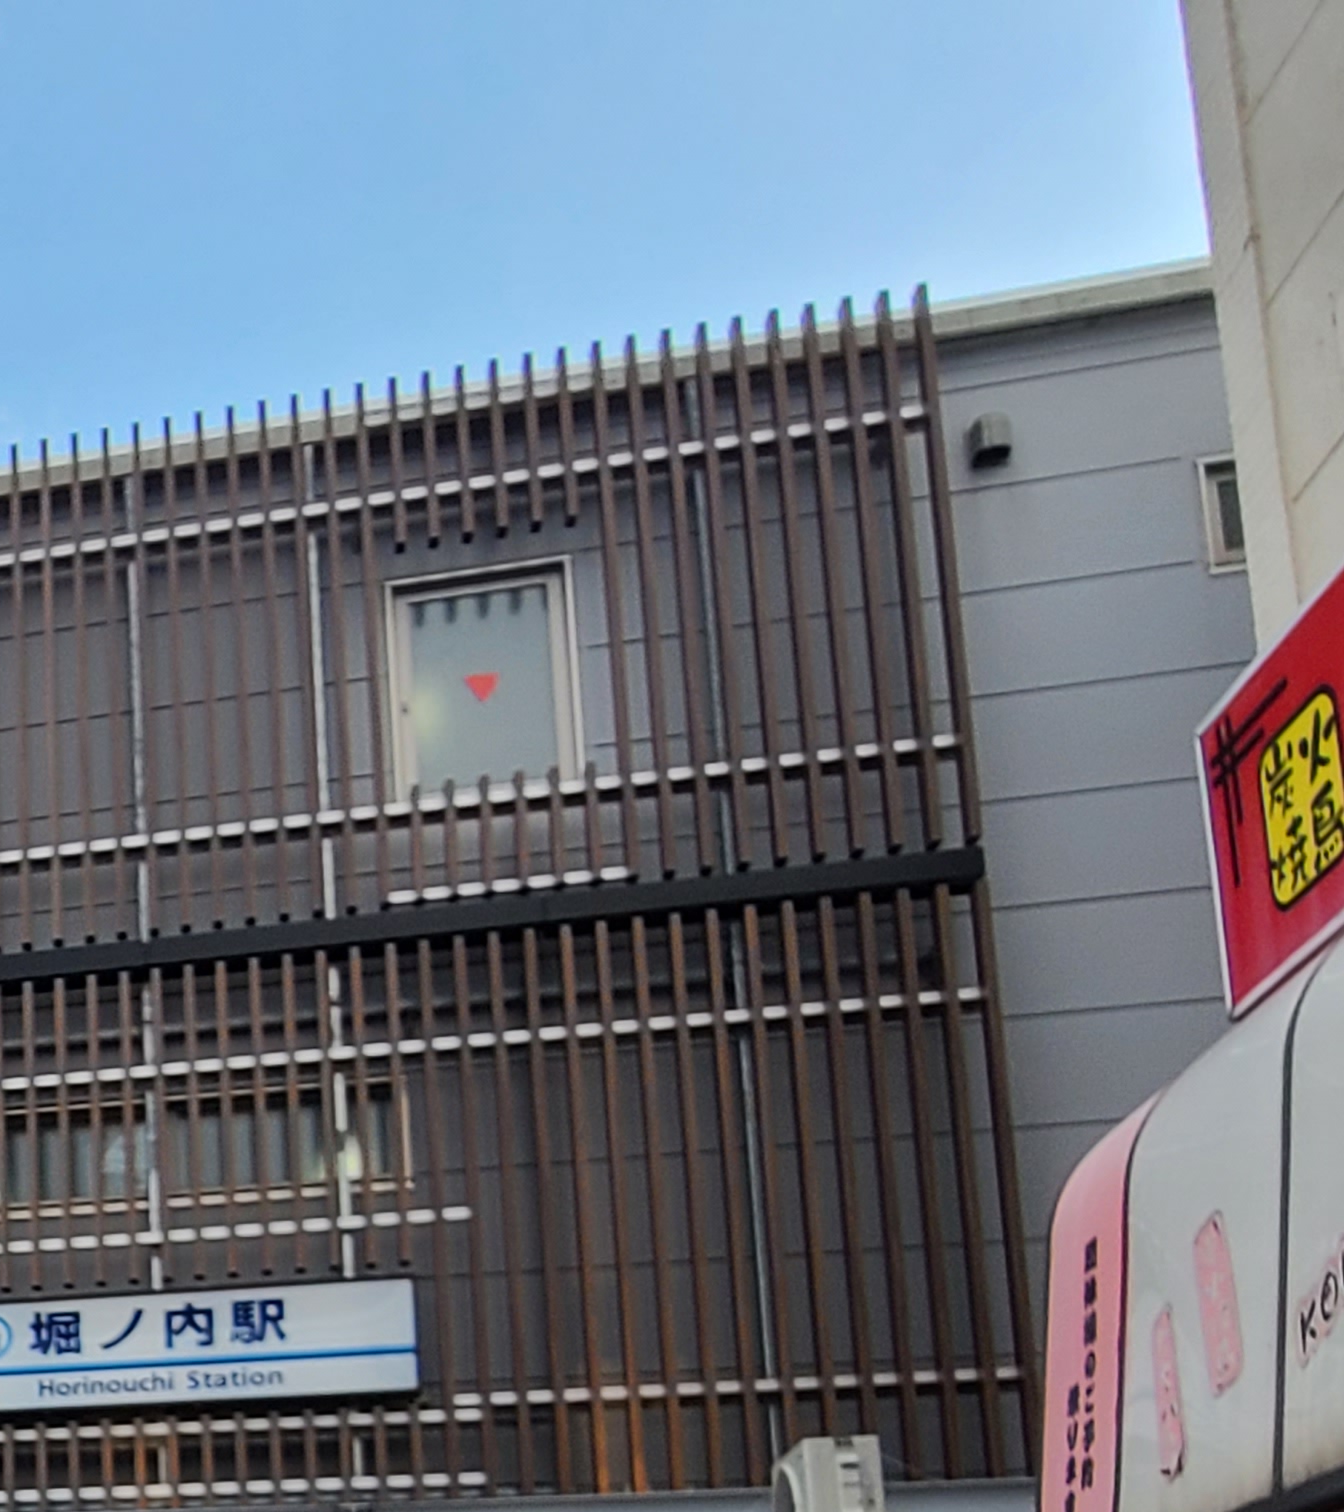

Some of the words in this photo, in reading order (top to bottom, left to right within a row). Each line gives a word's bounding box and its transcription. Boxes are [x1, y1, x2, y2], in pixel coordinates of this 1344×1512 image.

[30, 1298, 286, 1356] 堀ノ内駅
[38, 1373, 174, 1398] Horinouchi
[187, 1368, 284, 1391] Station
